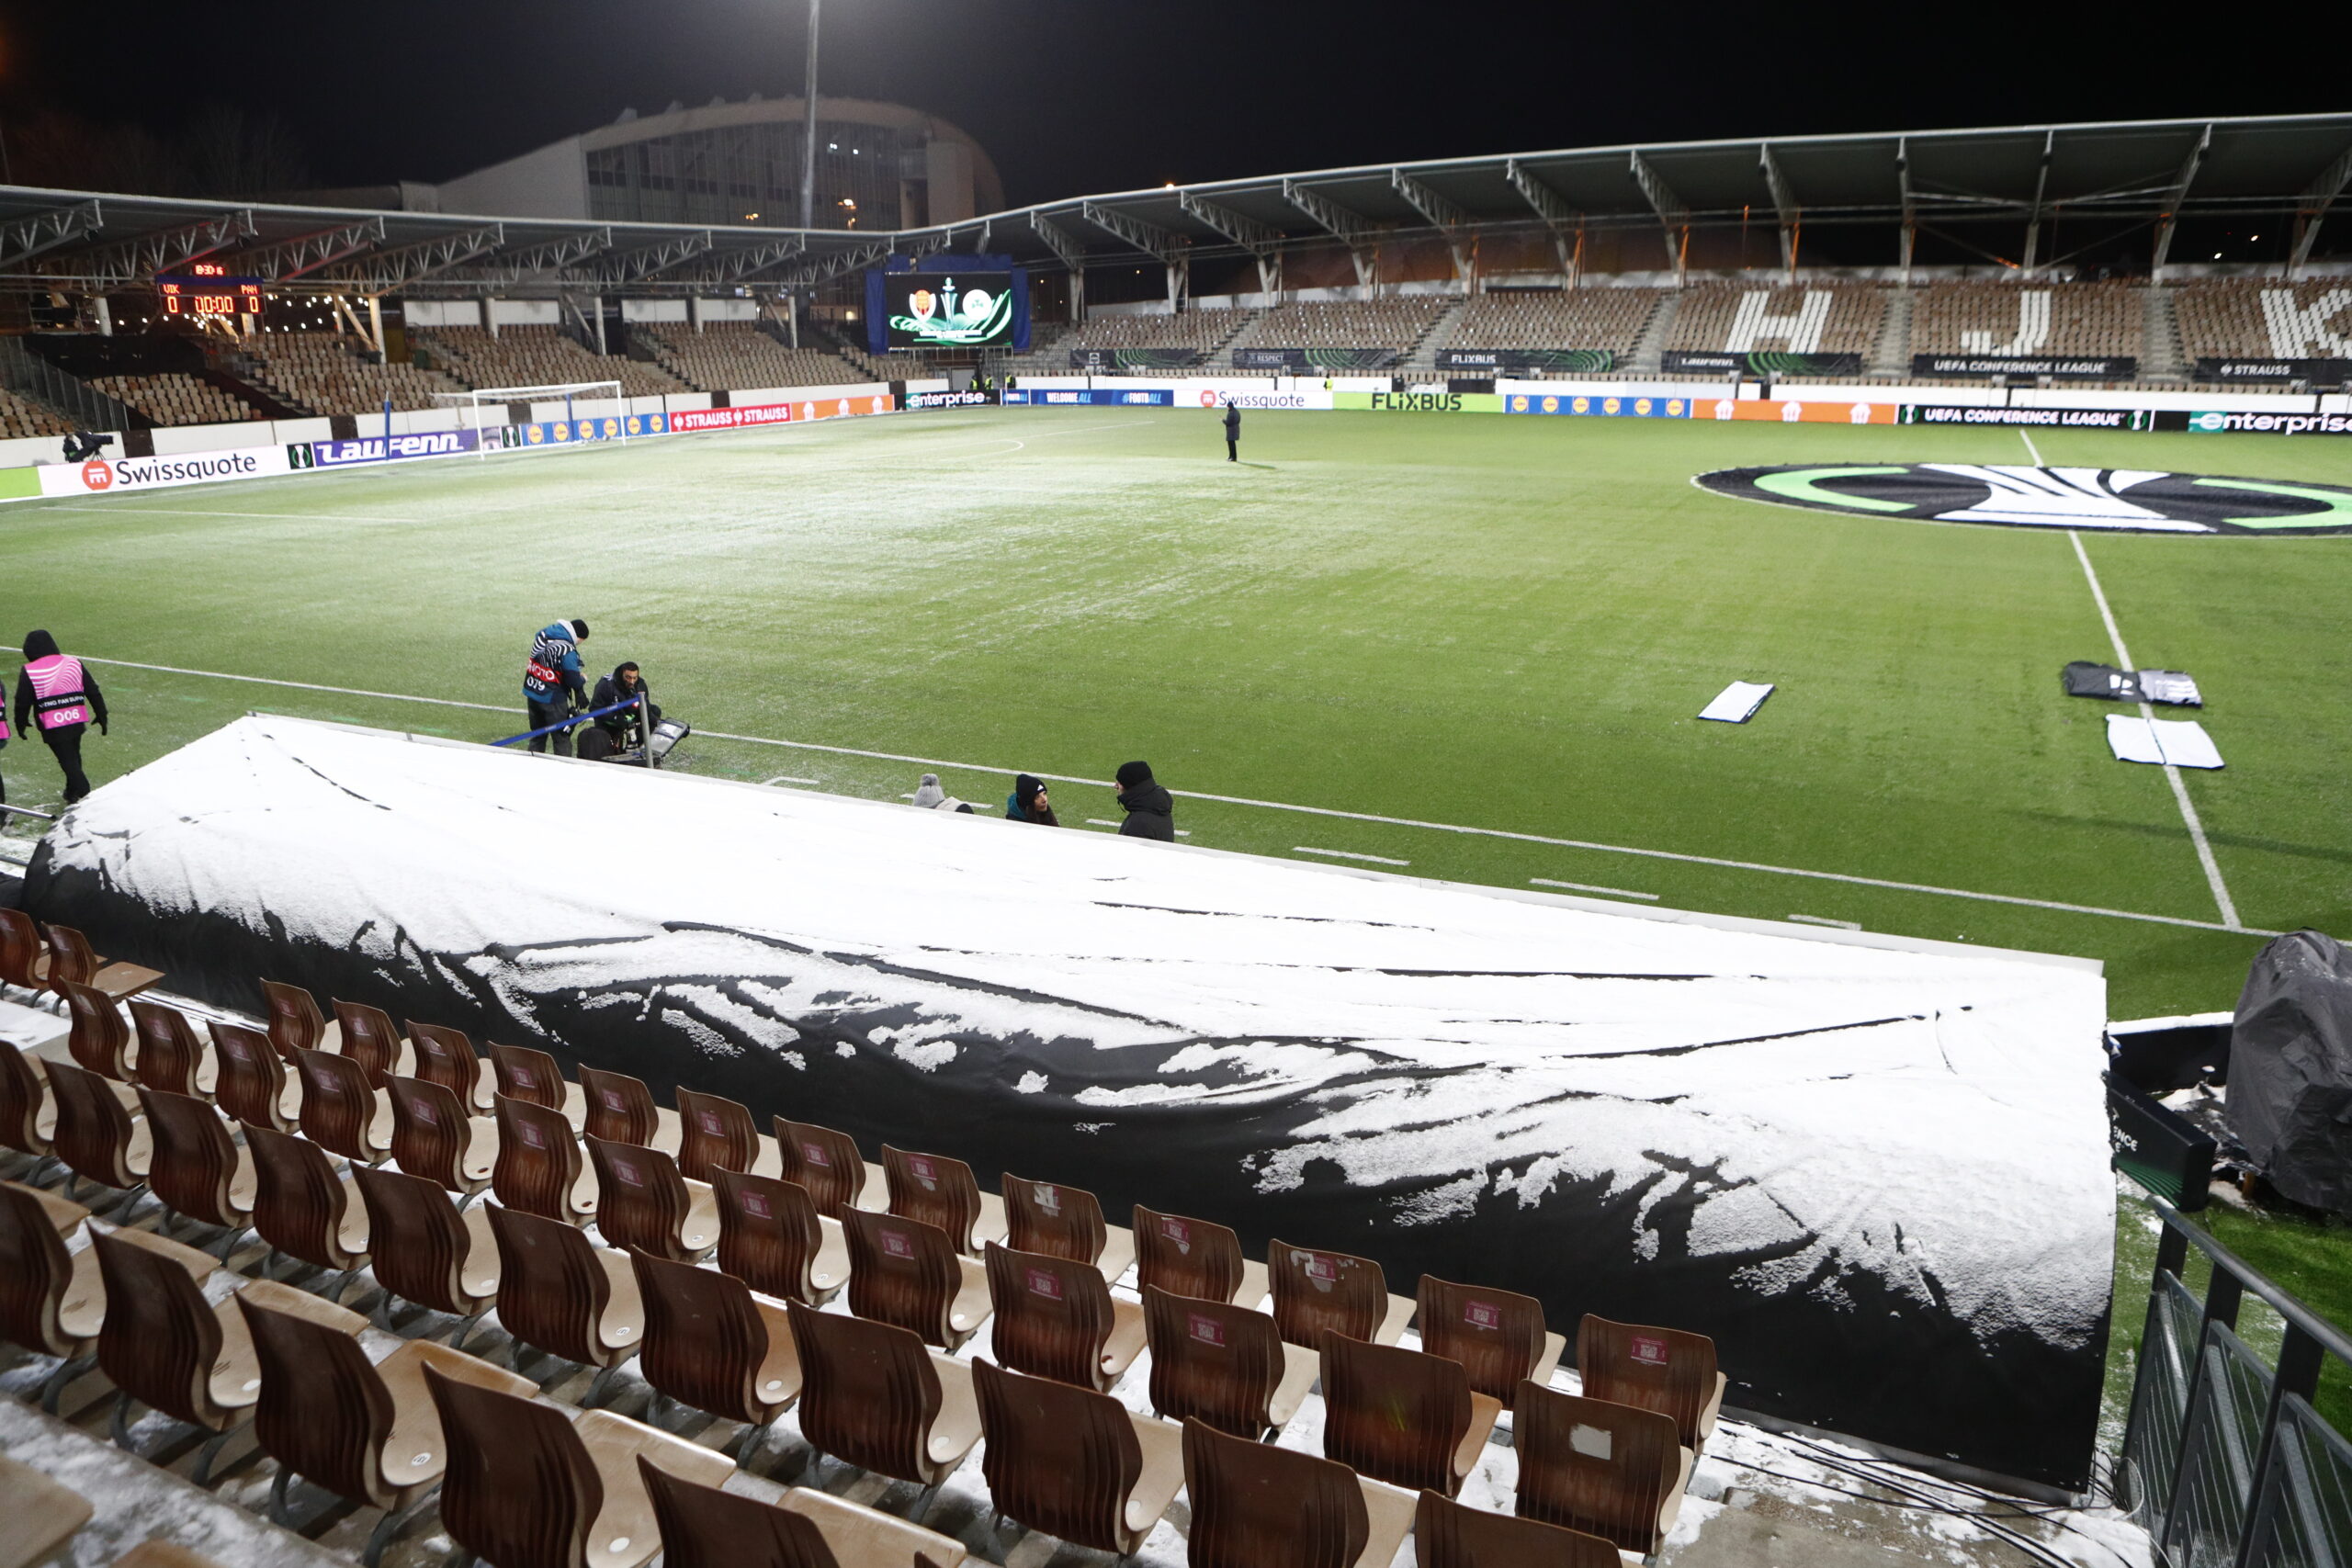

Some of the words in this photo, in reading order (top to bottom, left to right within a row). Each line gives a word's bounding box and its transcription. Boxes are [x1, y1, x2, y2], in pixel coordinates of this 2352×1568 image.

[241, 285, 258, 295] PAN
[167, 296, 178, 313] 0
[195, 296, 233, 313] 00:00
[249, 296, 259, 313] 0
[1934, 360, 1965, 371] UEFA
[1969, 361, 2052, 373] CONFERENCE
[2054, 362, 2106, 373] LEAGUE
[2233, 365, 2290, 376] STRAUSS
[908, 389, 985, 407] enterprise
[1046, 392, 1078, 403] WELCOME
[1079, 392, 1091, 403] ALL
[1122, 392, 1161, 404] #FOOTBALL
[1218, 390, 1306, 410] Swissquote
[684, 411, 732, 428] STRAUSS
[744, 407, 787, 423] STRAUSS
[1924, 409, 1962, 422] UEFA
[1964, 409, 2059, 424] CONFERENCE
[2062, 411, 2120, 426] LEAGUE
[116, 453, 256, 485] Swissquote
